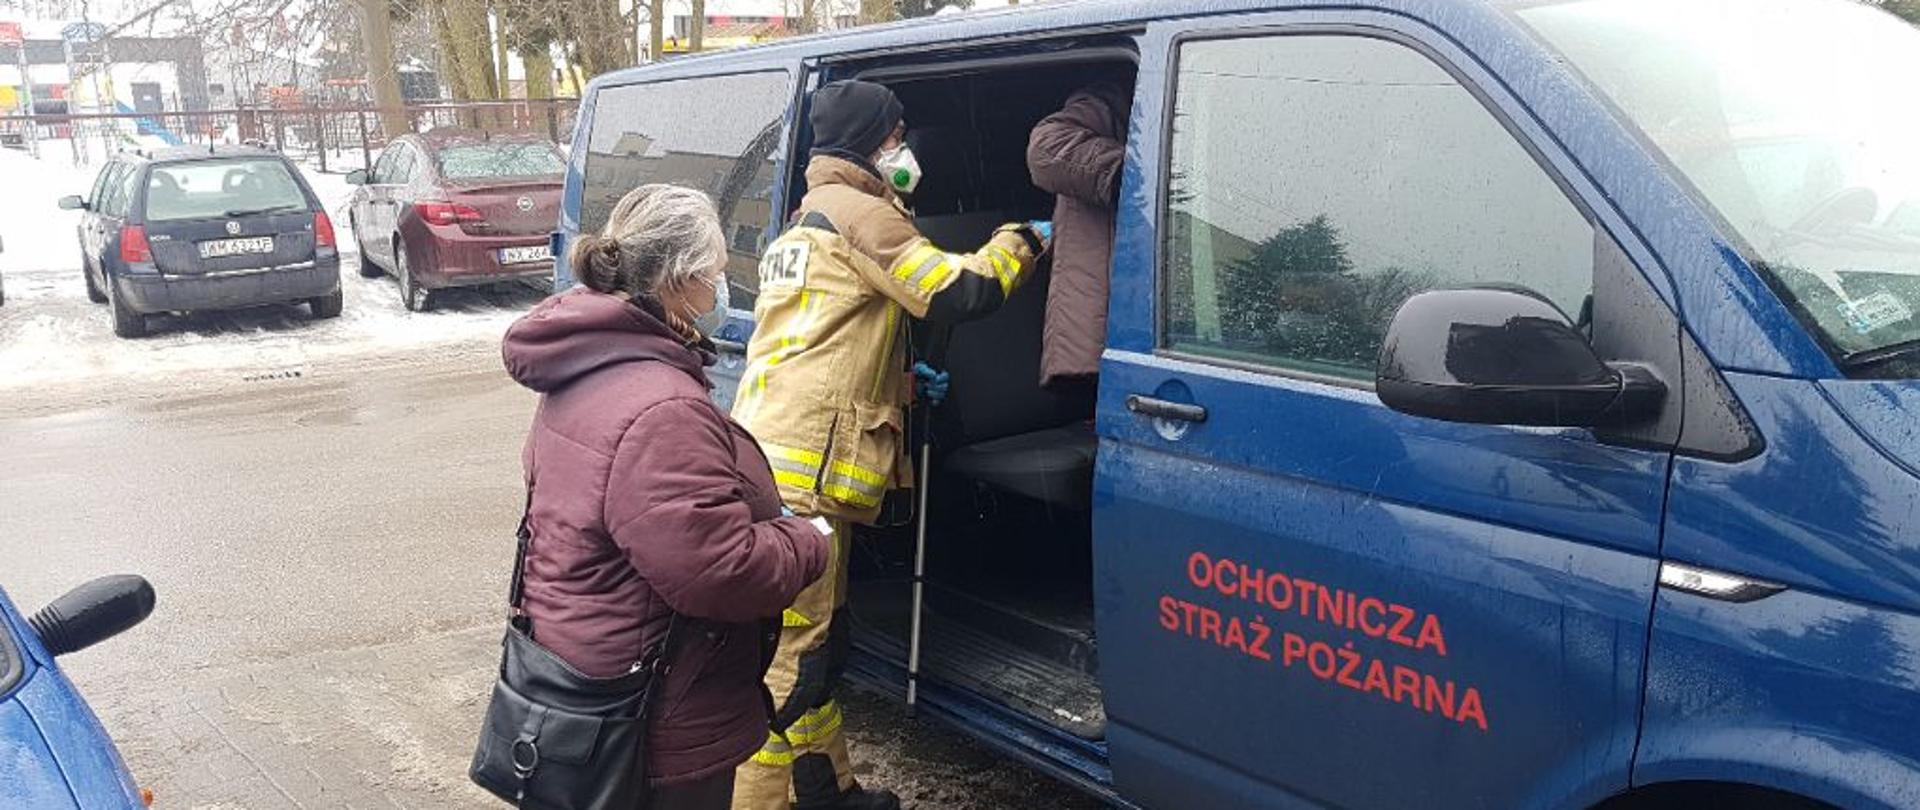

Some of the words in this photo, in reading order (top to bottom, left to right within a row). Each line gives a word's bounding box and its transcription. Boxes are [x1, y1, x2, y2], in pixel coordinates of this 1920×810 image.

[1159, 595, 1271, 661] STRAŻ
[1283, 632, 1488, 730] POŻARNA
[1188, 551, 1447, 656] OCHOTNICZA
